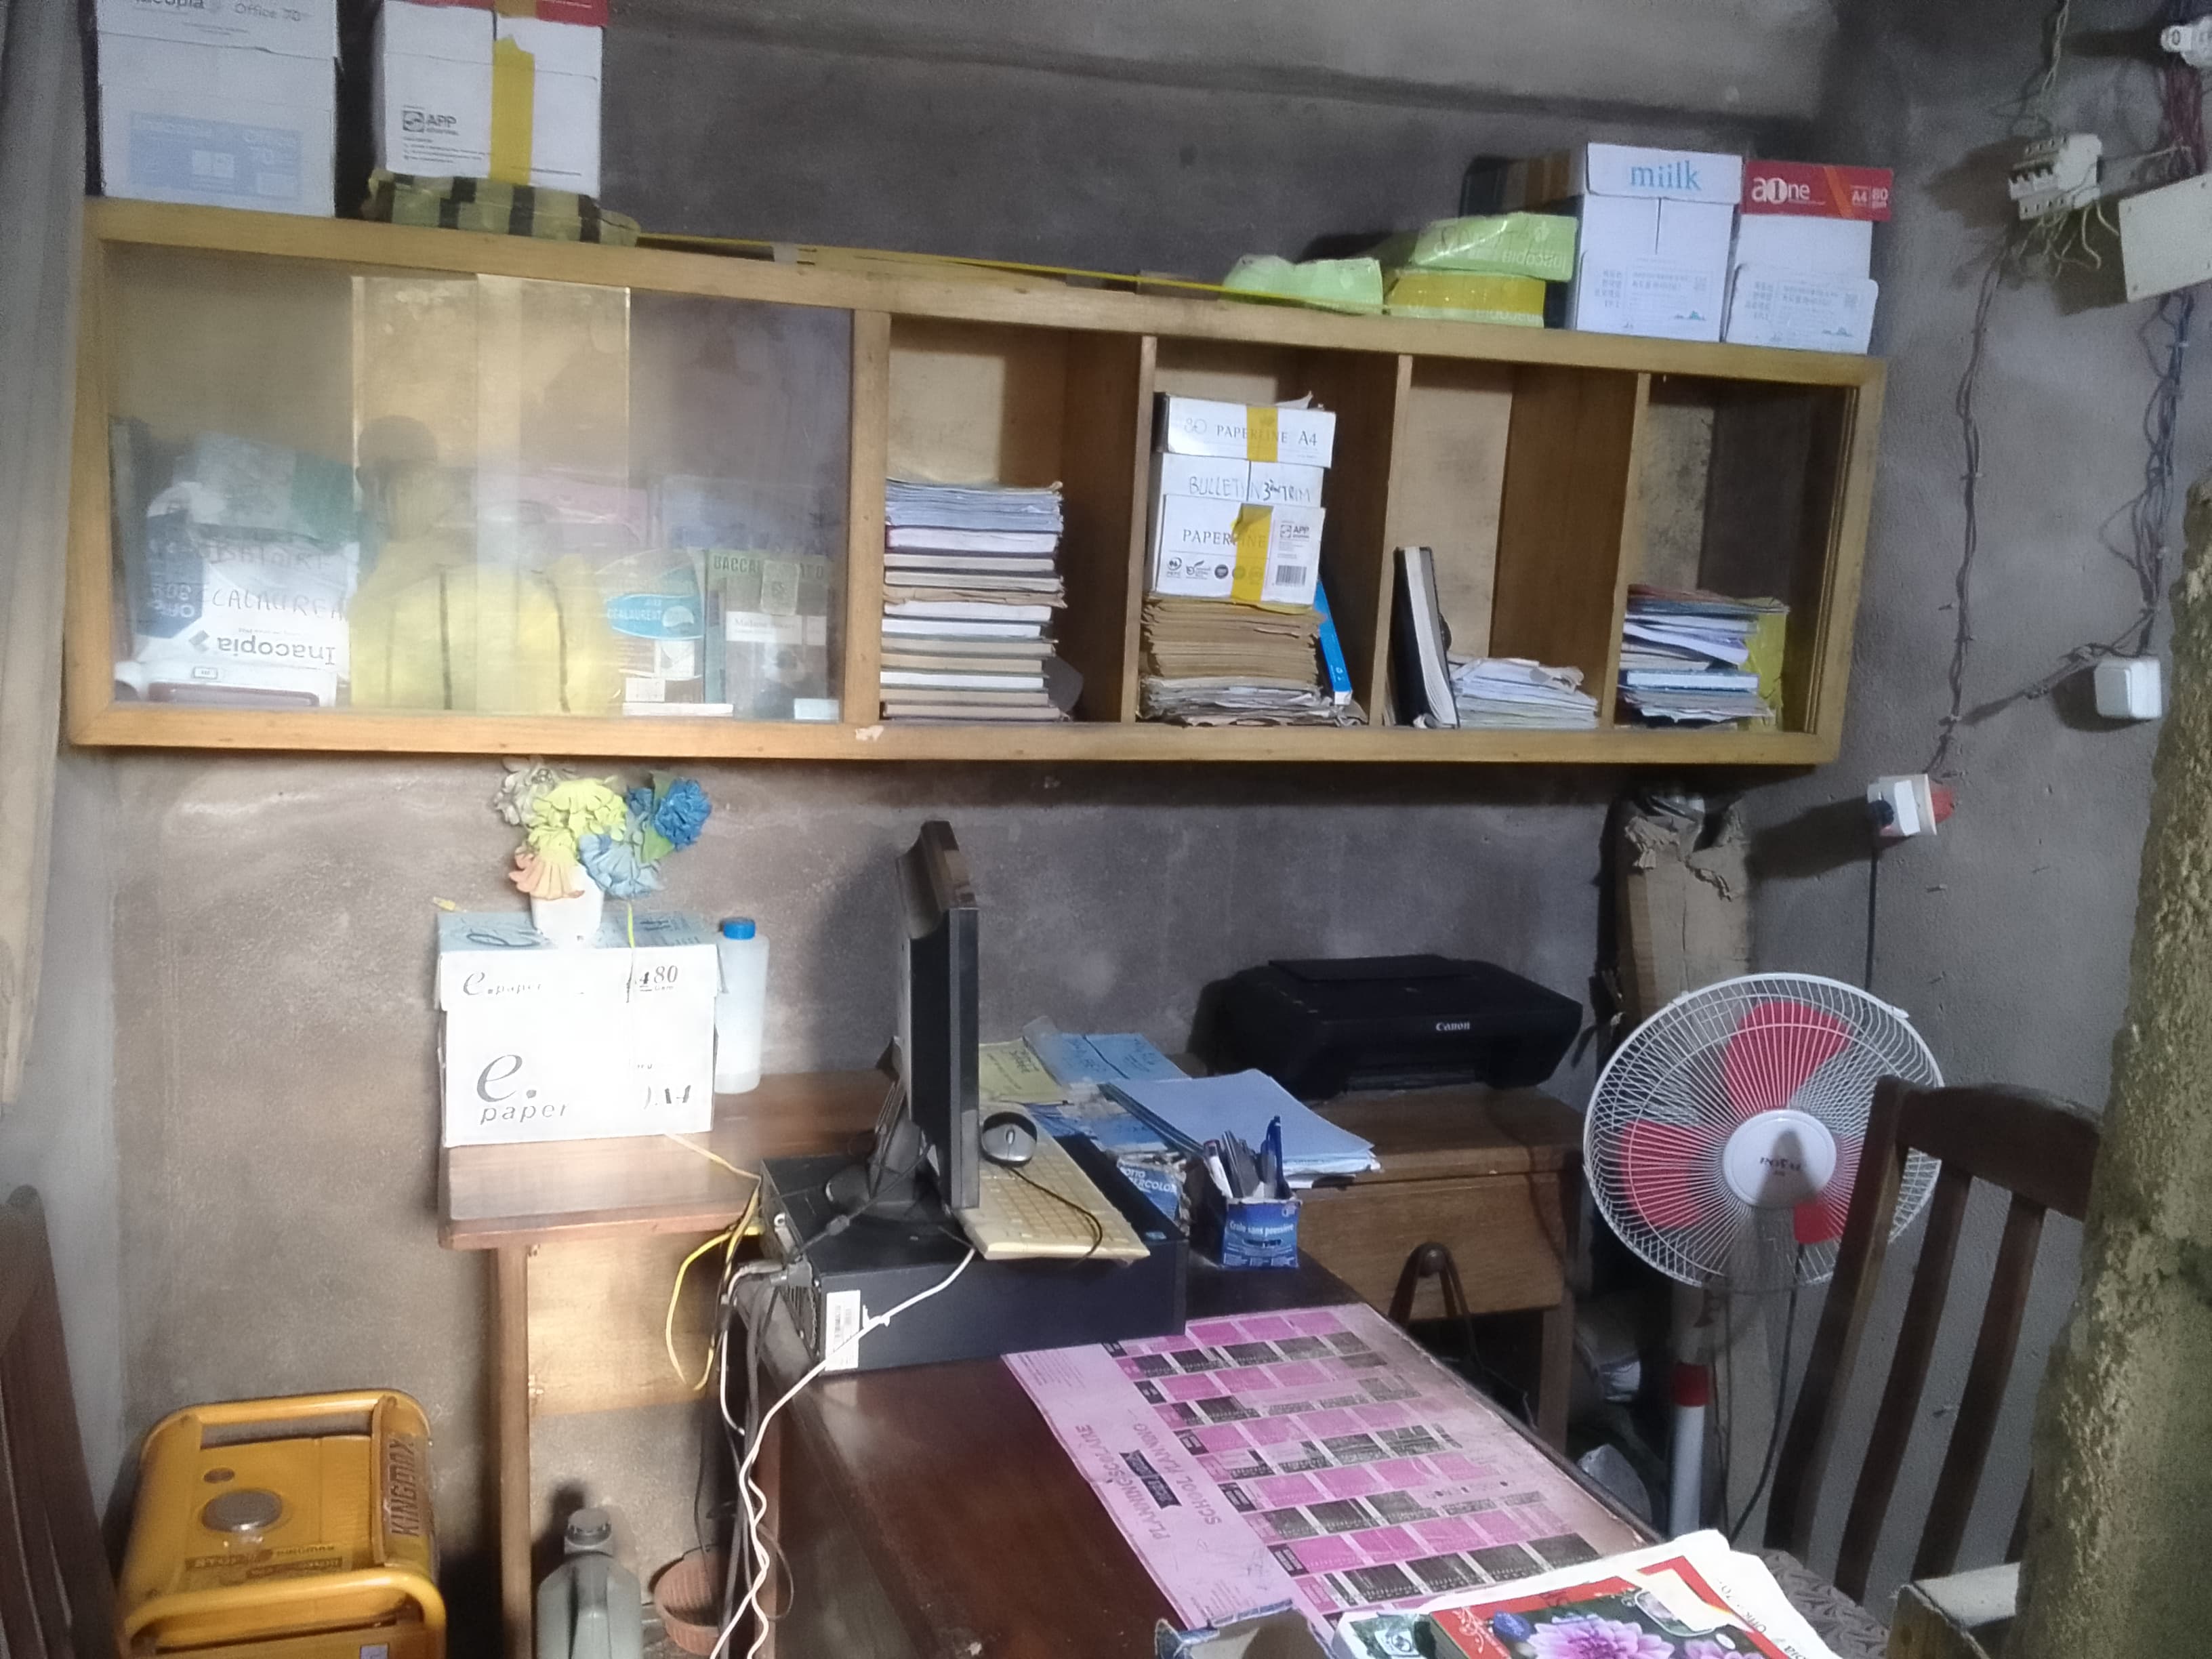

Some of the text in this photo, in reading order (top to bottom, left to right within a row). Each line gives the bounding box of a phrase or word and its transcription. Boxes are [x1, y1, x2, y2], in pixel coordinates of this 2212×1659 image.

[1298, 430, 1318, 447] A4
[217, 635, 336, 665] Inacopia
[1435, 1021, 1471, 1031] Canon
[480, 1101, 569, 1126] paper
[1132, 1422, 1186, 1475] PLANNING
[1176, 1475, 1223, 1525] SCHOOL
